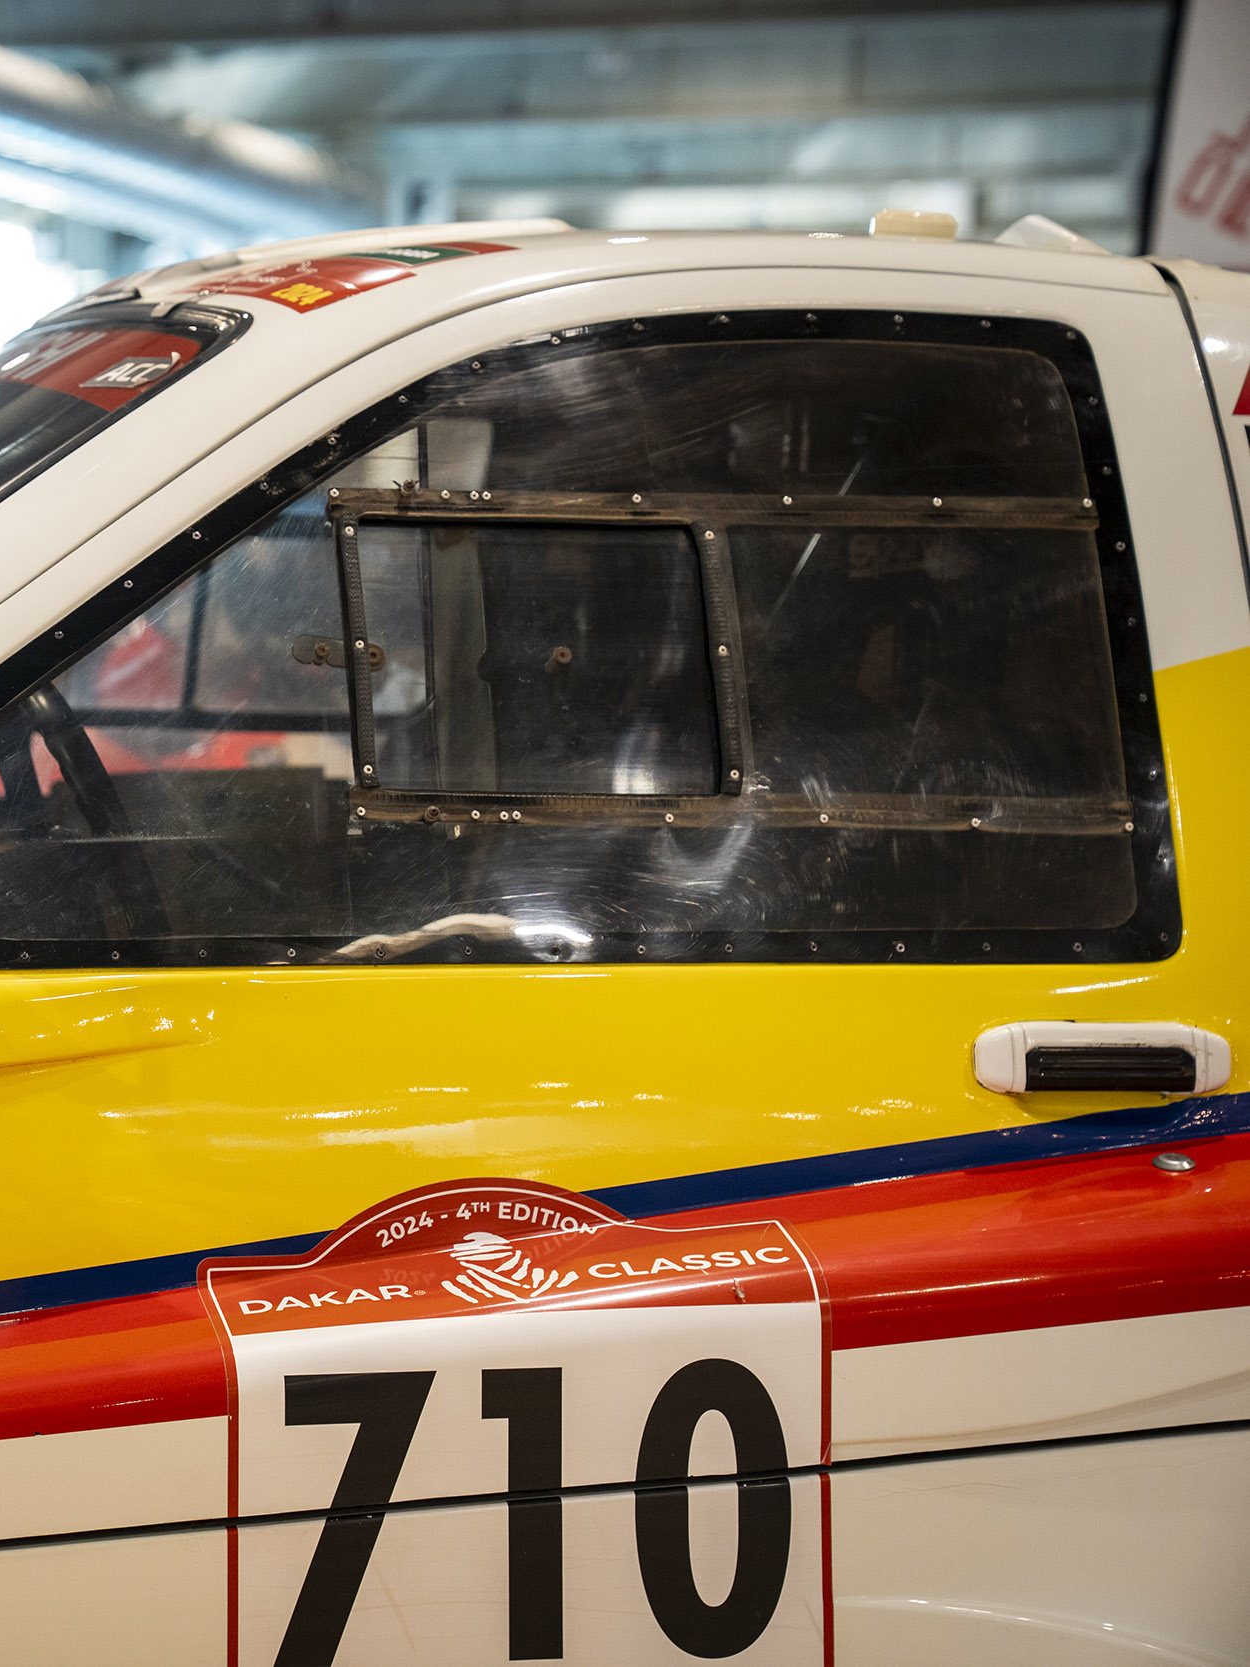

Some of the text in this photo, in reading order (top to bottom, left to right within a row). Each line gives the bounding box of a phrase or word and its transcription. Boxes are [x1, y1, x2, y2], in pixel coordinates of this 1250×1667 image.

[376, 1211, 434, 1248] 2024
[456, 1201, 491, 1221] 4TH
[498, 1201, 599, 1235] EDITION
[238, 1247, 791, 1315] DAKAR CLASSIC
[272, 1357, 792, 1667] 710
